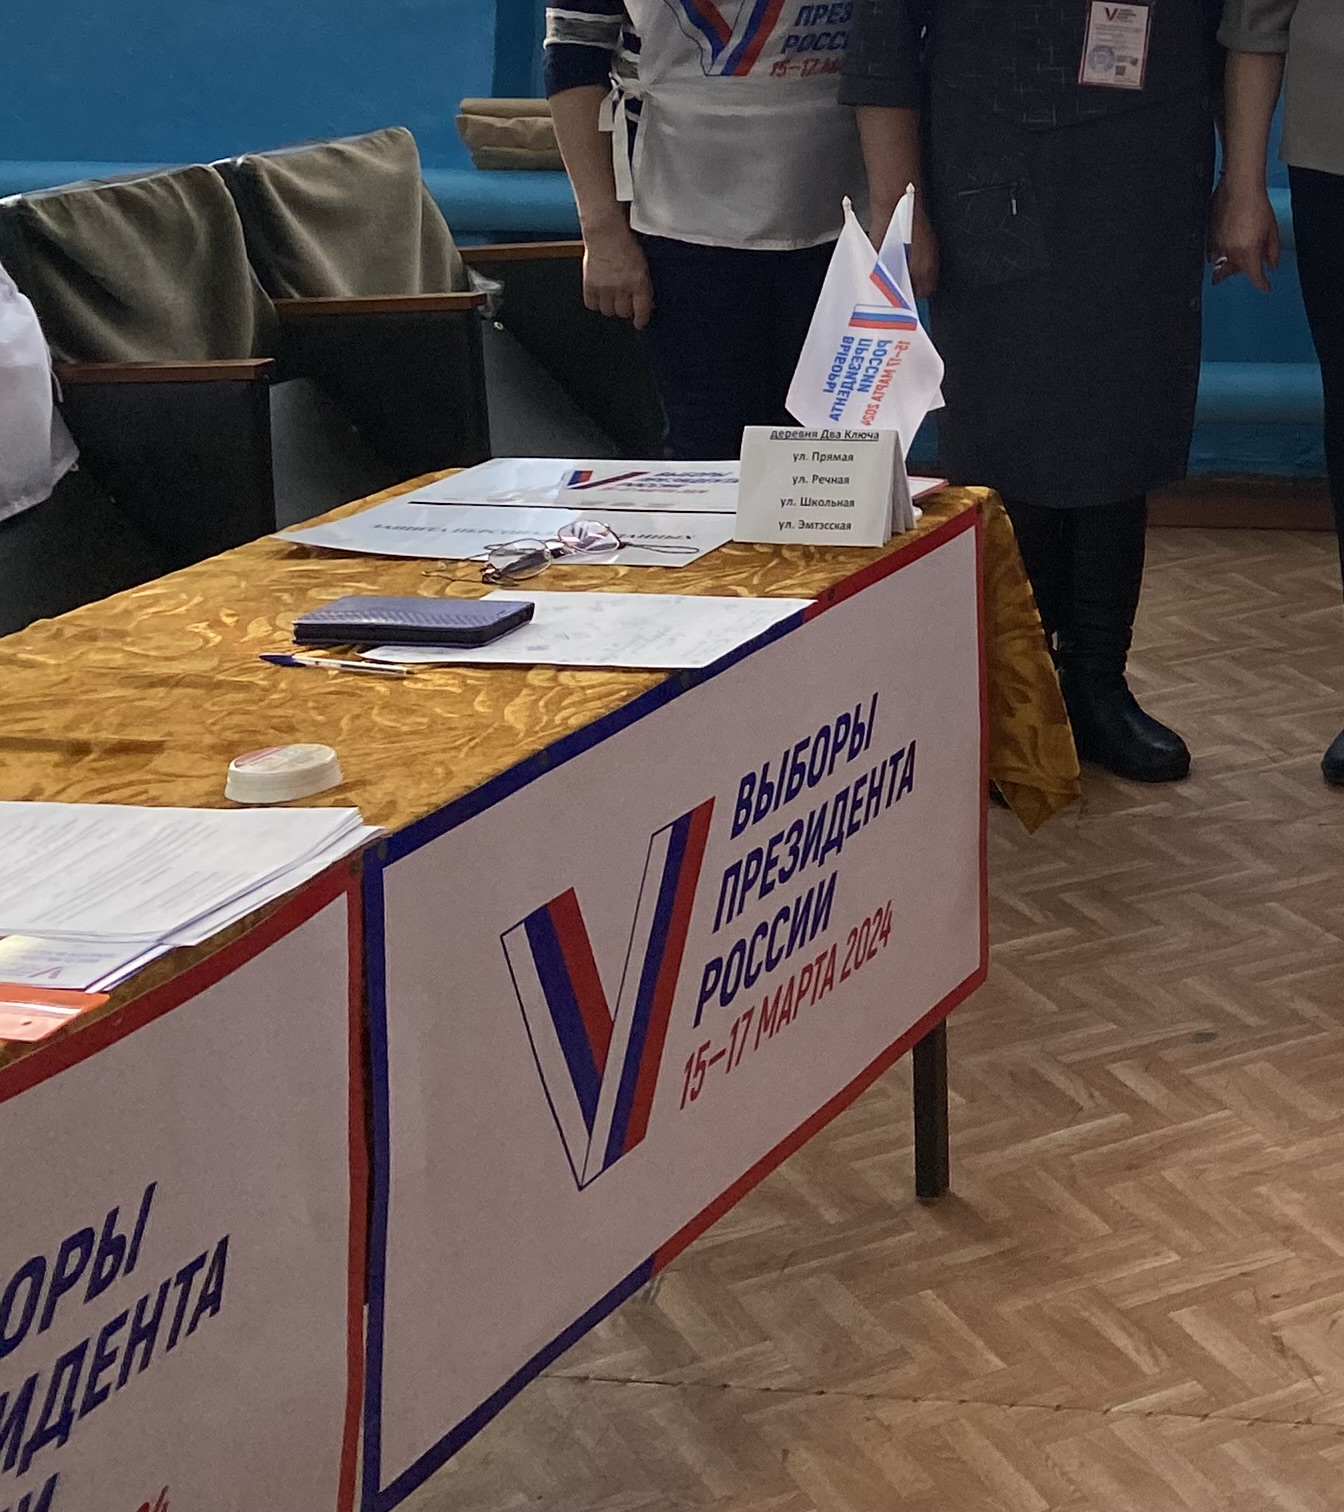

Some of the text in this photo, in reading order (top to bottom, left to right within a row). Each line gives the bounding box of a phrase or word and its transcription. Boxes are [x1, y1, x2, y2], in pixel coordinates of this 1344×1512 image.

[770, 430, 879, 441] деревня Два Ключа
[793, 452, 854, 462] ул. Прямая
[792, 474, 850, 484] ул. Речная
[780, 497, 855, 507] ул. Школьная
[778, 520, 852, 530] ул. Эмтэсская
[730, 692, 879, 840] ВЫБОРЫ
[712, 740, 917, 934] ПРЕЗИДЕНТА
[693, 870, 838, 1029] РОССИИ
[754, 942, 838, 1051] МАРТА
[839, 899, 893, 983] 2024
